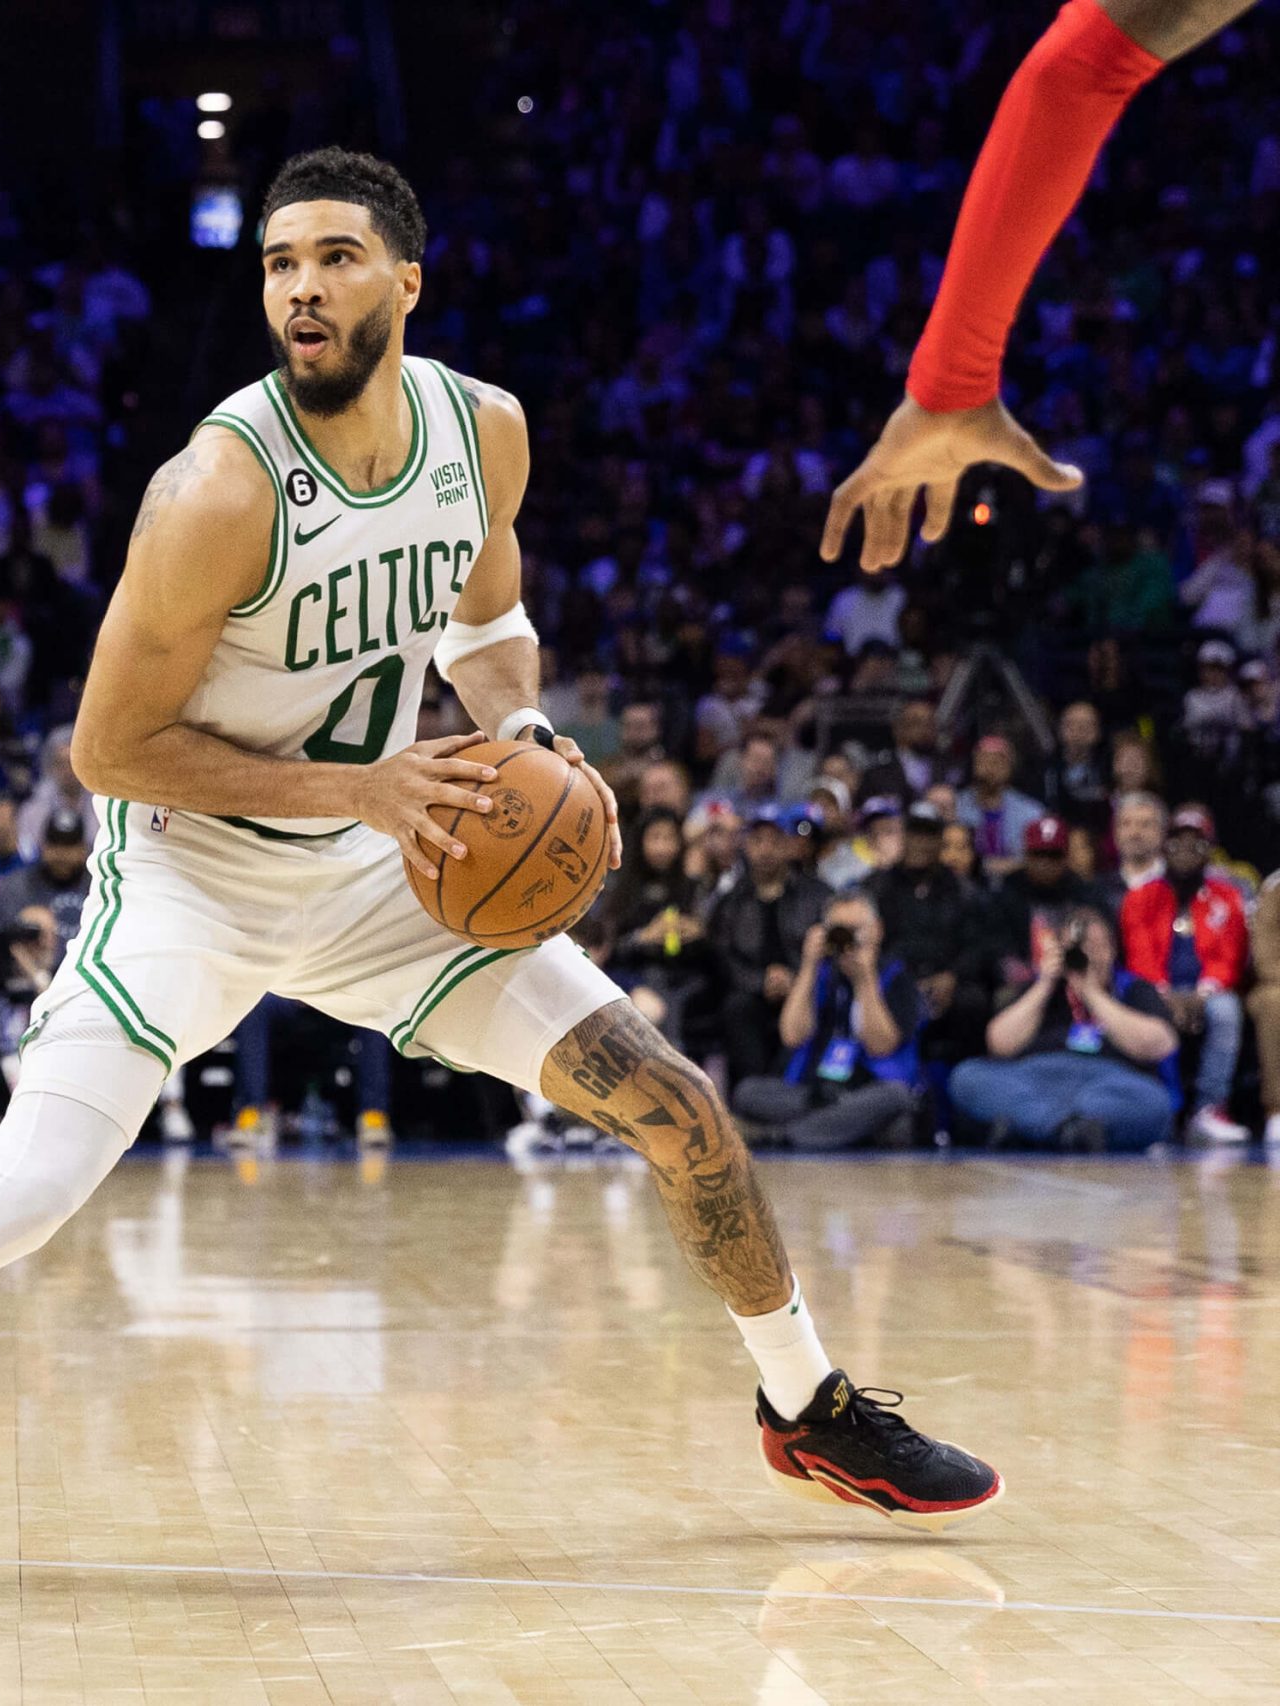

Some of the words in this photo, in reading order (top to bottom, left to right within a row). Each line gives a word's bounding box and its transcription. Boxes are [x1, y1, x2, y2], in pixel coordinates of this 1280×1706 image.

[292, 473, 314, 502] 6
[430, 461, 468, 490] VISTA
[436, 483, 469, 508] PRINT
[285, 540, 473, 672] CELTICS
[302, 653, 405, 765] 0
